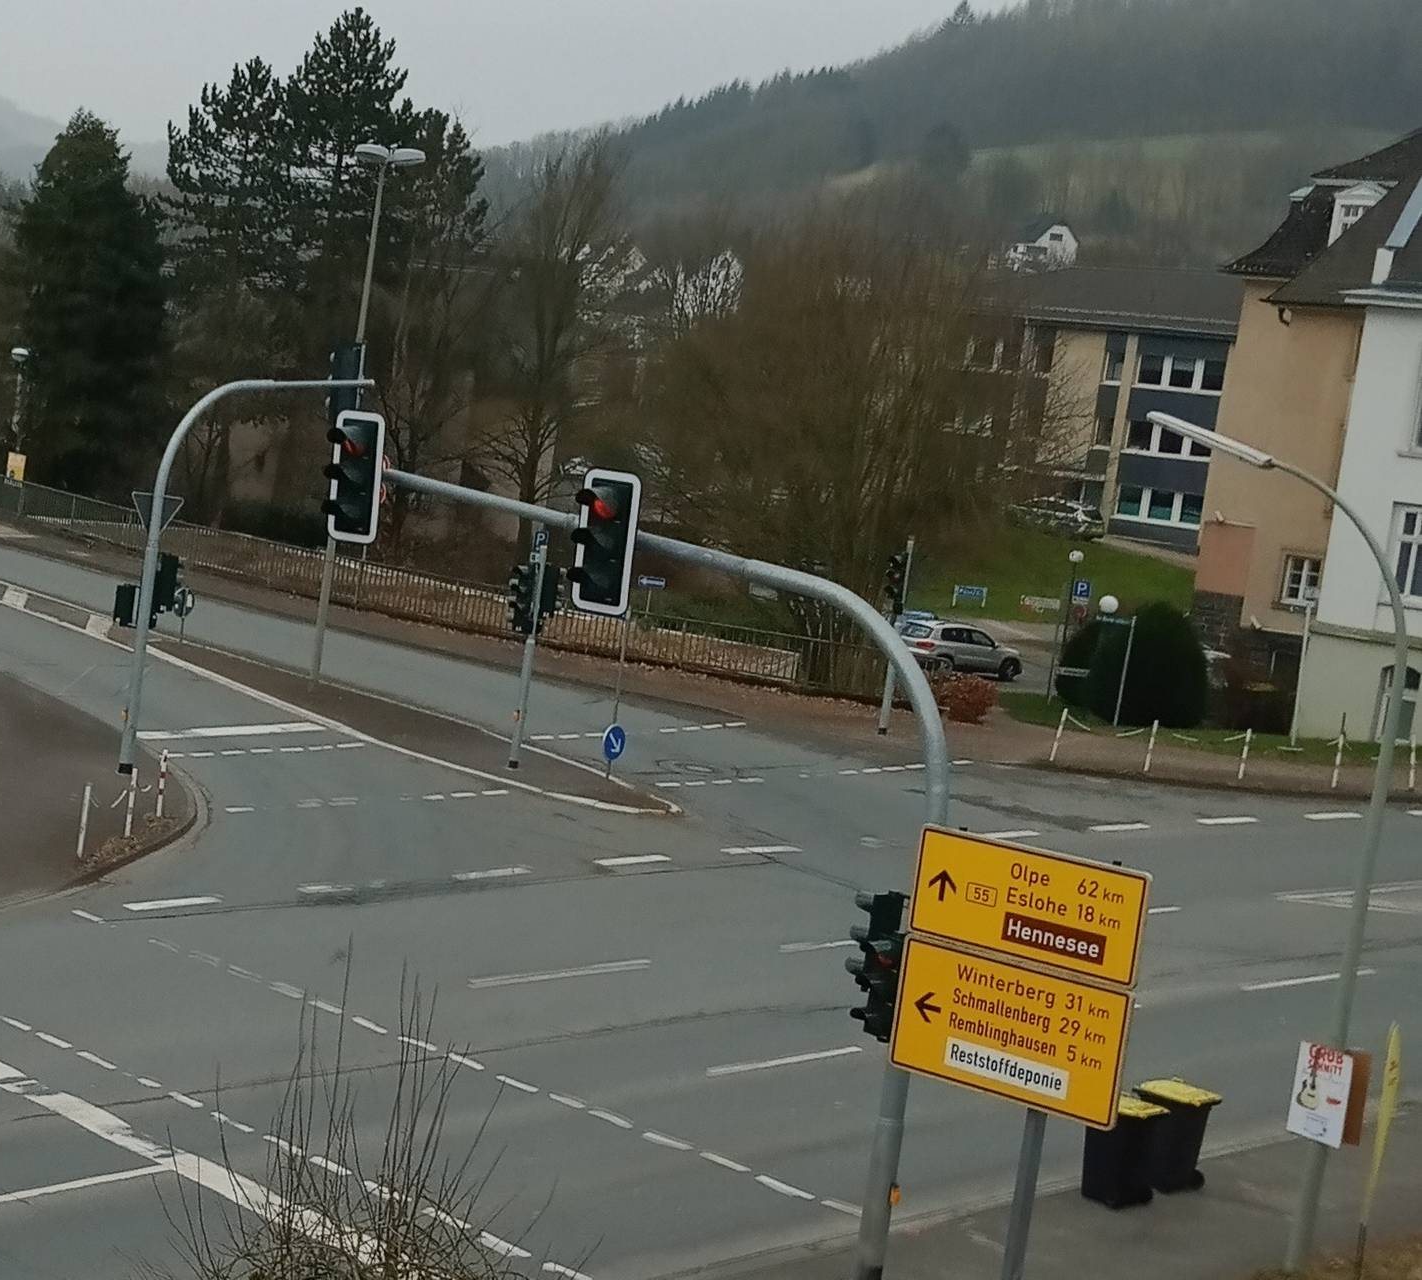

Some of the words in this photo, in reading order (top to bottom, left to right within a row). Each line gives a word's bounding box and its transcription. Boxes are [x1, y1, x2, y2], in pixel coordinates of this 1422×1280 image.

[1077, 582, 1087, 595] P
[973, 888, 990, 902] 55
[1011, 863, 1050, 887] Olpe
[1078, 878, 1099, 898] 62
[1103, 888, 1124, 904] km
[1006, 888, 1067, 916] Eslohe
[1078, 904, 1094, 922] 18
[1099, 912, 1121, 929] km
[1007, 918, 1099, 958] Hennesee
[957, 964, 1056, 1009] Winterberg
[1065, 993, 1083, 1012] 31
[1088, 1003, 1110, 1020] km
[953, 988, 1050, 1033] Schmallenberg
[1059, 1017, 1081, 1036] 29
[1084, 1028, 1106, 1045] km
[949, 1012, 1056, 1057] Remblinghausen
[1067, 1045, 1076, 1062] 5
[1081, 1054, 1102, 1070] km
[950, 1044, 1062, 1090] Reststoffdeponie
